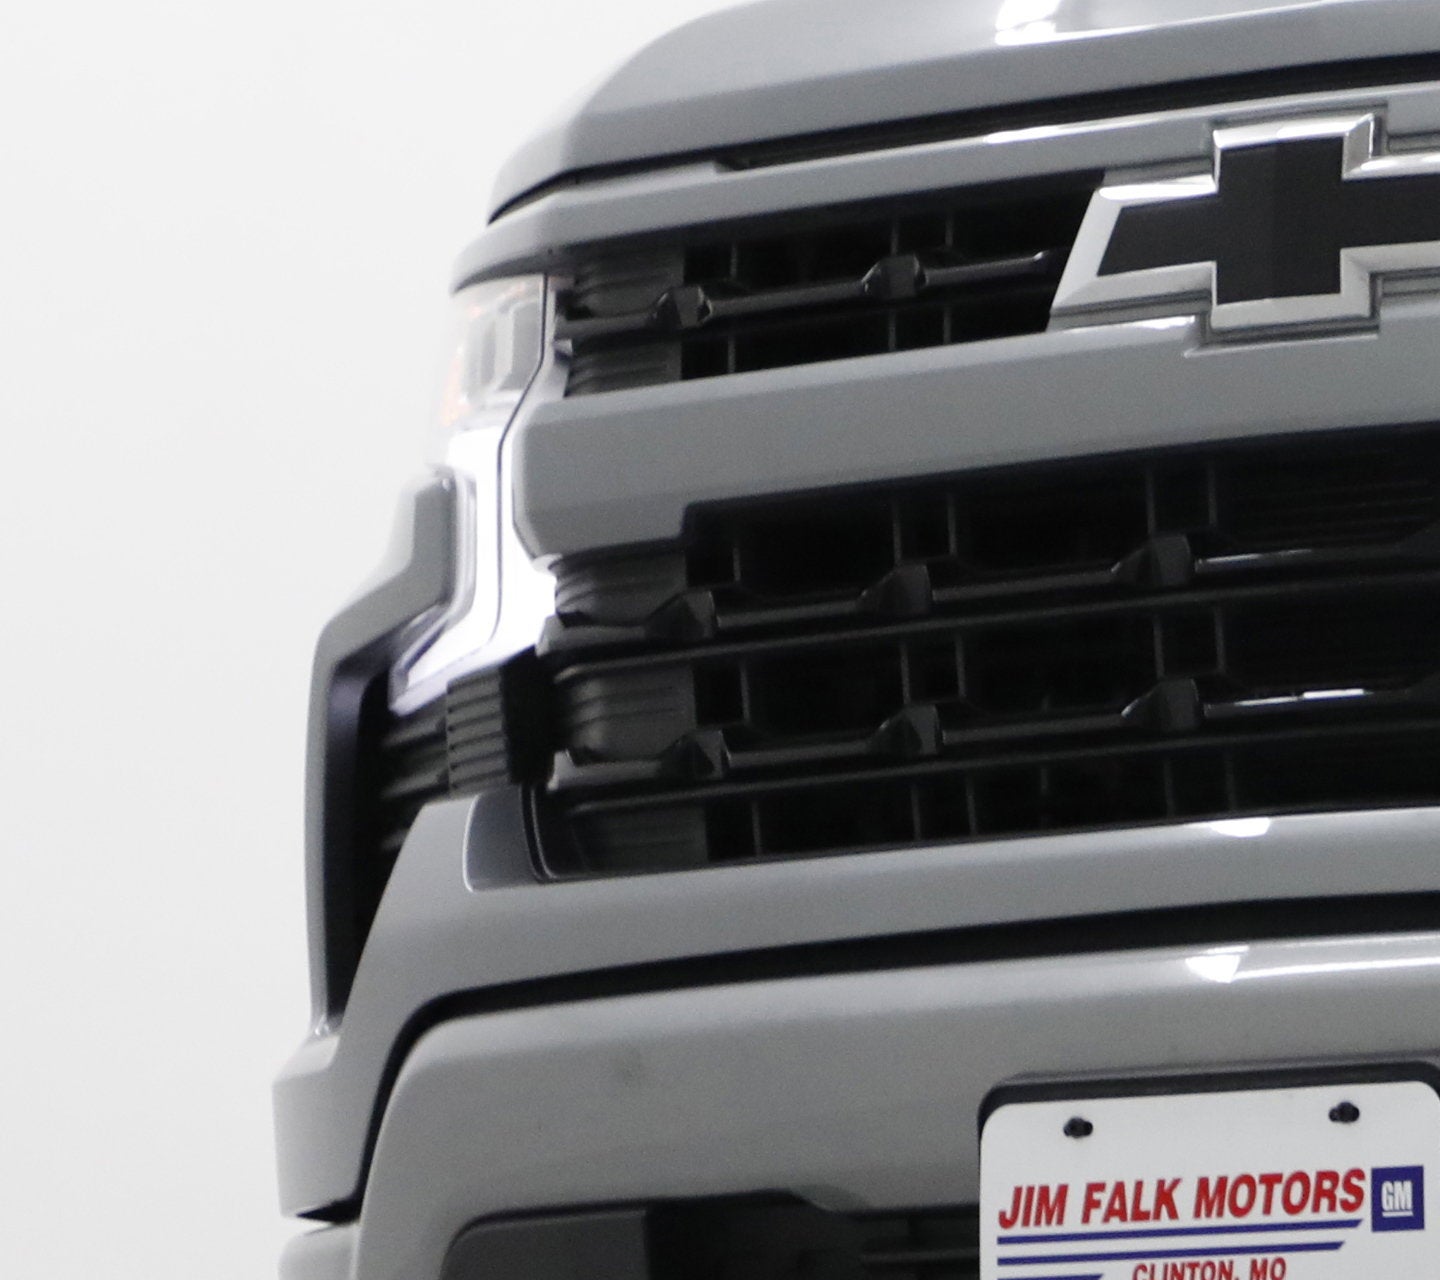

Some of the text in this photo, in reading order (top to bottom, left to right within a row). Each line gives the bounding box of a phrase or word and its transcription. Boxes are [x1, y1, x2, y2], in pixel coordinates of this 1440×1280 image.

[999, 1167, 1366, 1230] JIM FALK MOTORS
[1381, 1180, 1413, 1212] GM
